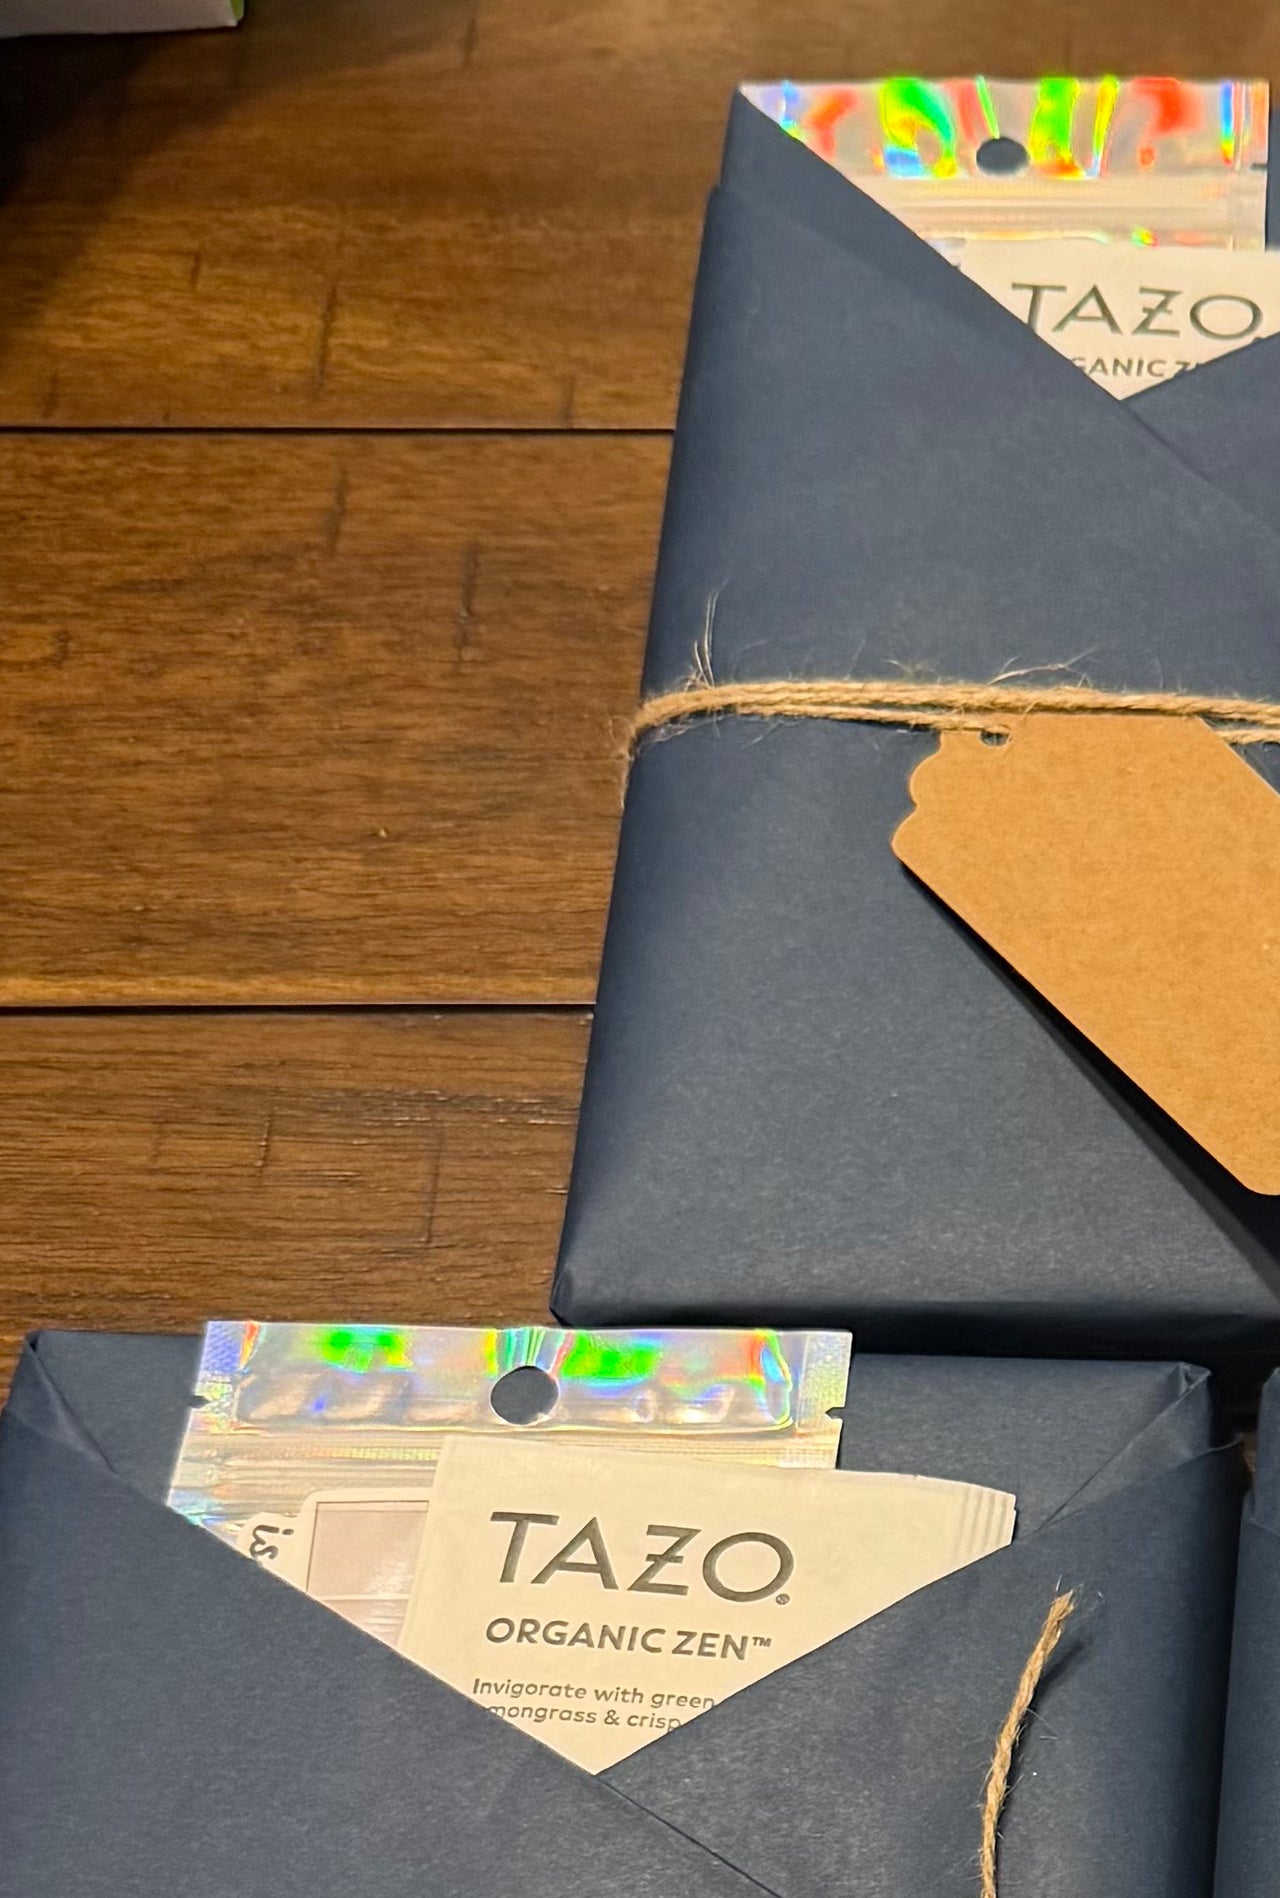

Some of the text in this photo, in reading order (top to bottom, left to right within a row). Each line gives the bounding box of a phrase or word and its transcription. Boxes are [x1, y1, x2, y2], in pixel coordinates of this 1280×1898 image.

[486, 1617, 667, 1654] ORGANIC
[472, 1678, 715, 1709] Invigorate with green
[604, 1709, 620, 1726] &
[627, 1712, 682, 1733] crisp
